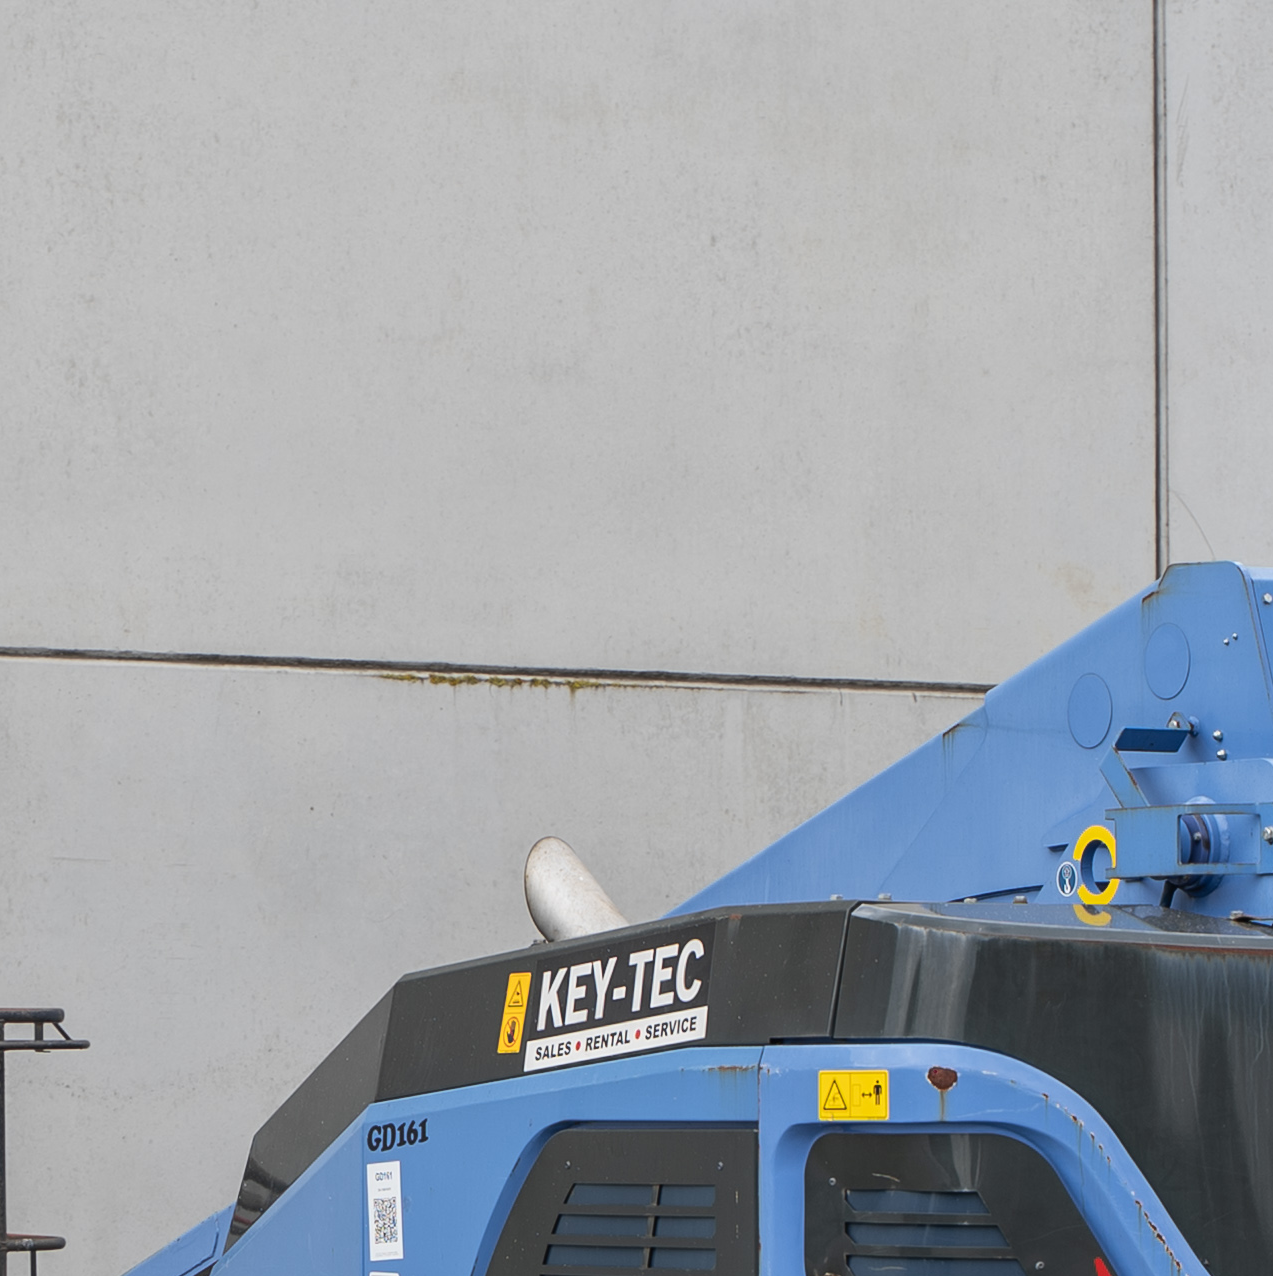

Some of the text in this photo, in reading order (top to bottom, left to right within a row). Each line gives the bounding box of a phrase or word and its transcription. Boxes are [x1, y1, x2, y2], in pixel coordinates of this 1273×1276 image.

[536, 938, 705, 1032] KEY-TEC
[534, 1015, 698, 1062] SALES RENTAL SERVICE
[367, 1117, 429, 1153] GD161
